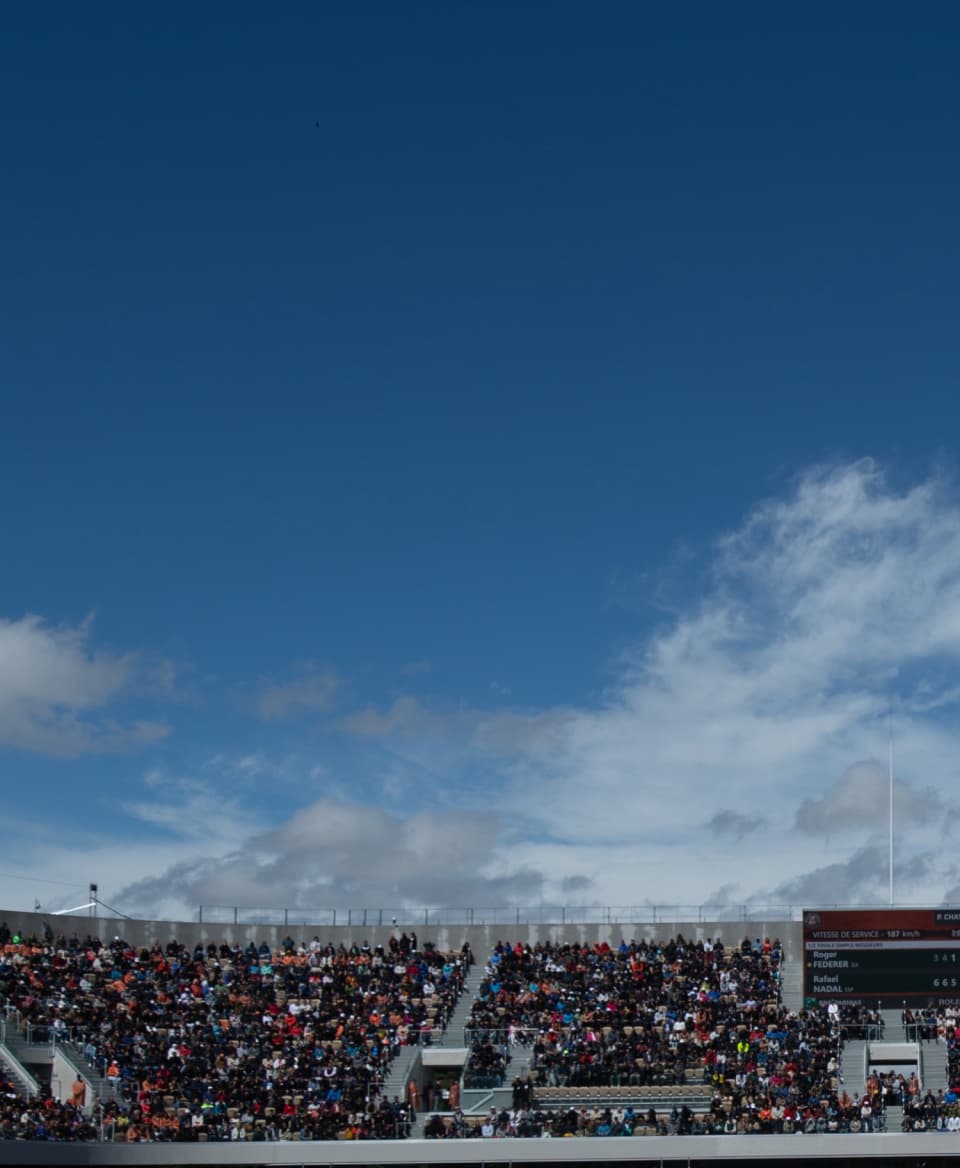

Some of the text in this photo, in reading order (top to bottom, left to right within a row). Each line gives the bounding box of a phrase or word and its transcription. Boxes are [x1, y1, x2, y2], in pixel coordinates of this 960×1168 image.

[813, 951, 837, 960] Roger
[813, 960, 848, 968] FEDERER
[813, 975, 839, 983] Rafael
[933, 978, 957, 986] 6 6 5
